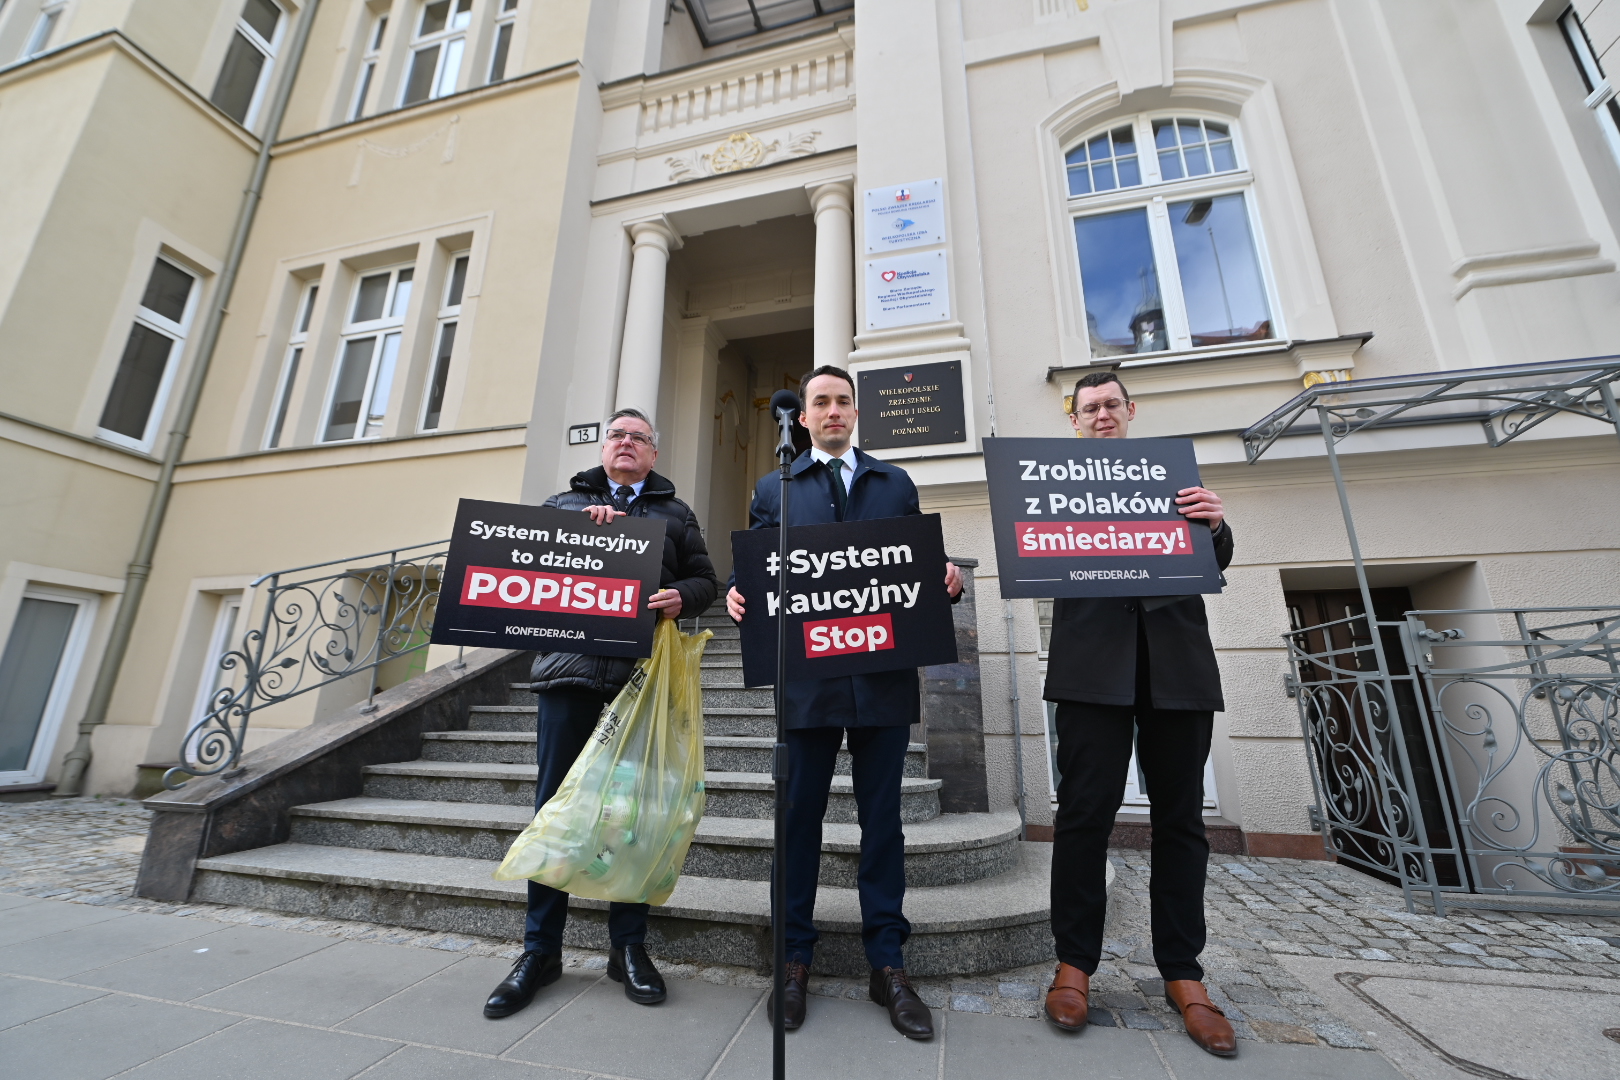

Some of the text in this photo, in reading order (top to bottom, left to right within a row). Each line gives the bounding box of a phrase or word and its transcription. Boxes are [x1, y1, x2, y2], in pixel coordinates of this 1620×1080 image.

[897, 271, 930, 280] Obywatelska
[879, 384, 940, 396] WIELKOPOLSKIE
[888, 396, 932, 406] ZRZESZENIE
[880, 408, 910, 418] HANDLU
[917, 405, 941, 414] USŁUG
[577, 428, 590, 442] 13
[892, 426, 930, 436] POZNANIU
[1018, 457, 1167, 481] Zrobiliście
[1024, 491, 1171, 515] z Polaków
[469, 520, 651, 555] System kaucyjny
[1022, 526, 1187, 554] śmieciarzy!
[511, 549, 604, 571] to dzieło
[766, 544, 913, 579] #System
[1069, 569, 1150, 581] KONFEDERACJA
[467, 571, 635, 613] POPiSu!
[766, 578, 922, 617] Kaucyjny
[504, 625, 586, 640] KONFEDERACJA
[809, 624, 888, 652] Stop
